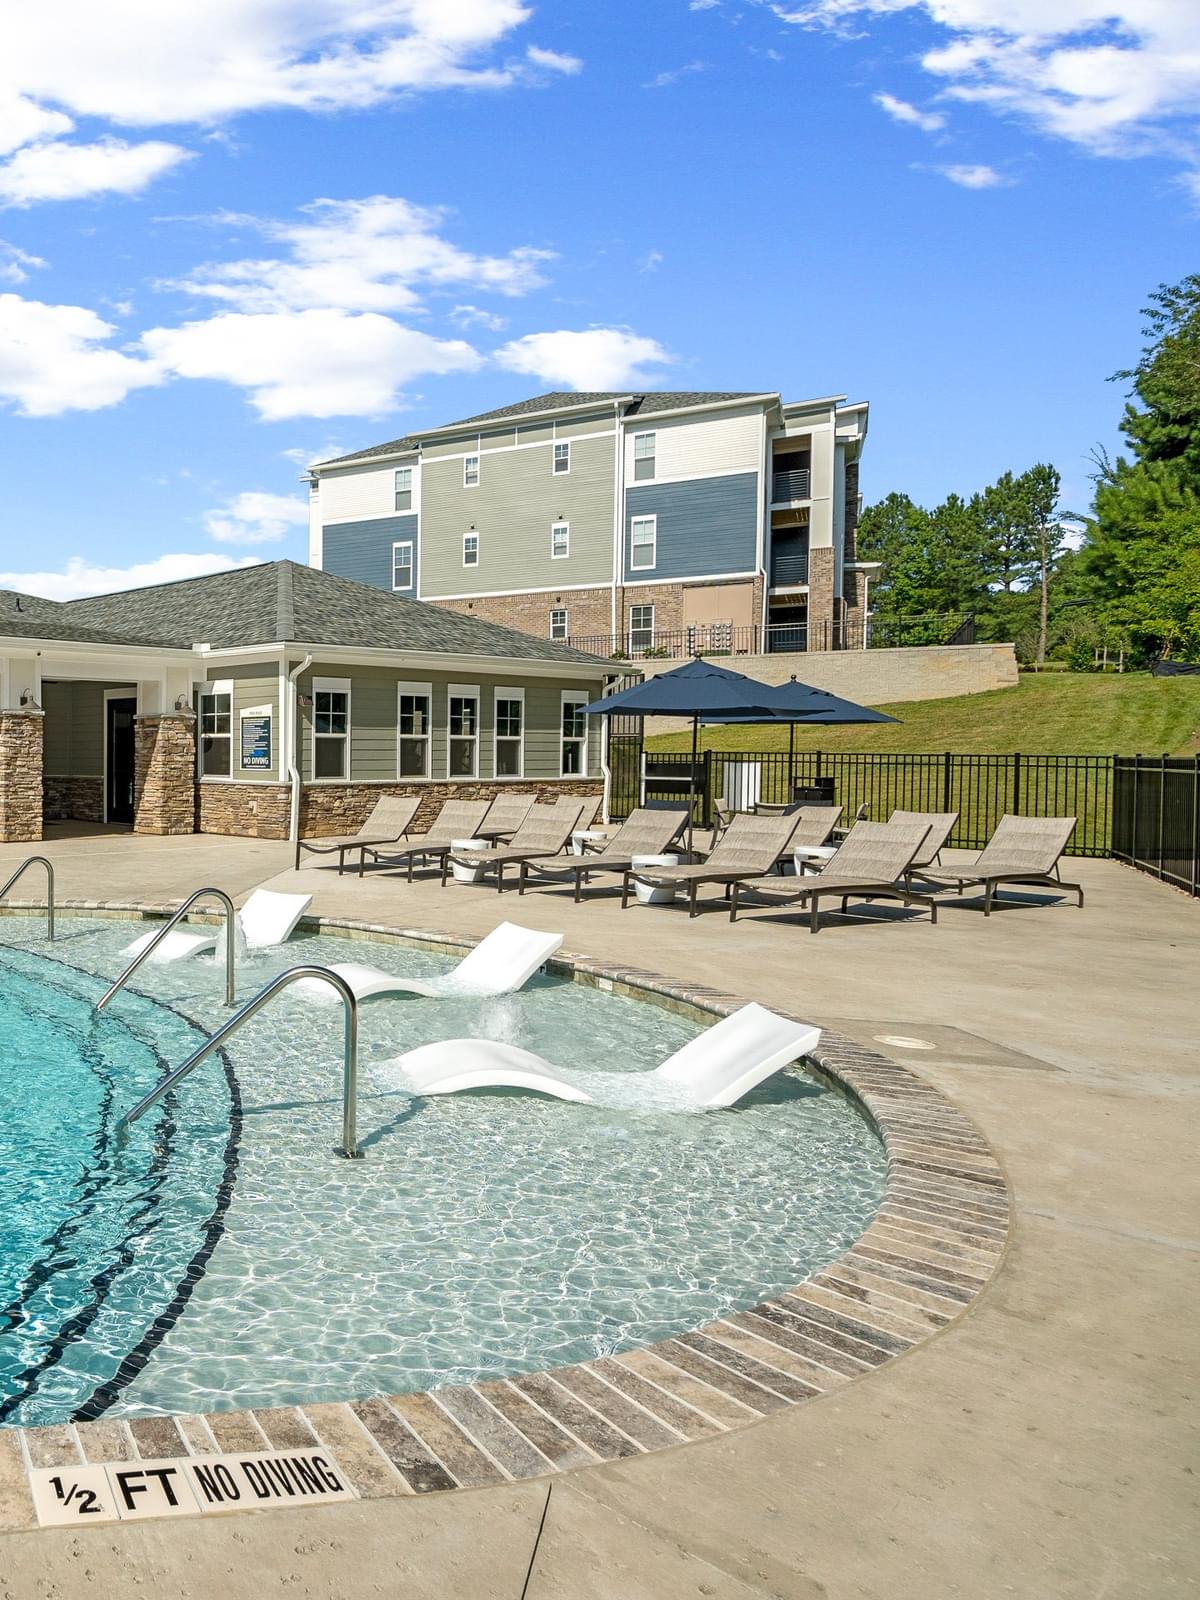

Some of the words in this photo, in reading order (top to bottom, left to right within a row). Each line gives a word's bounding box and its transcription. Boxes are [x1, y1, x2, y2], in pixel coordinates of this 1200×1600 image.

[243, 757, 251, 765] NO
[252, 757, 269, 765] DIVING
[116, 1467, 179, 1510] FT
[192, 1464, 241, 1502] NO
[239, 1455, 344, 1499] DIVING
